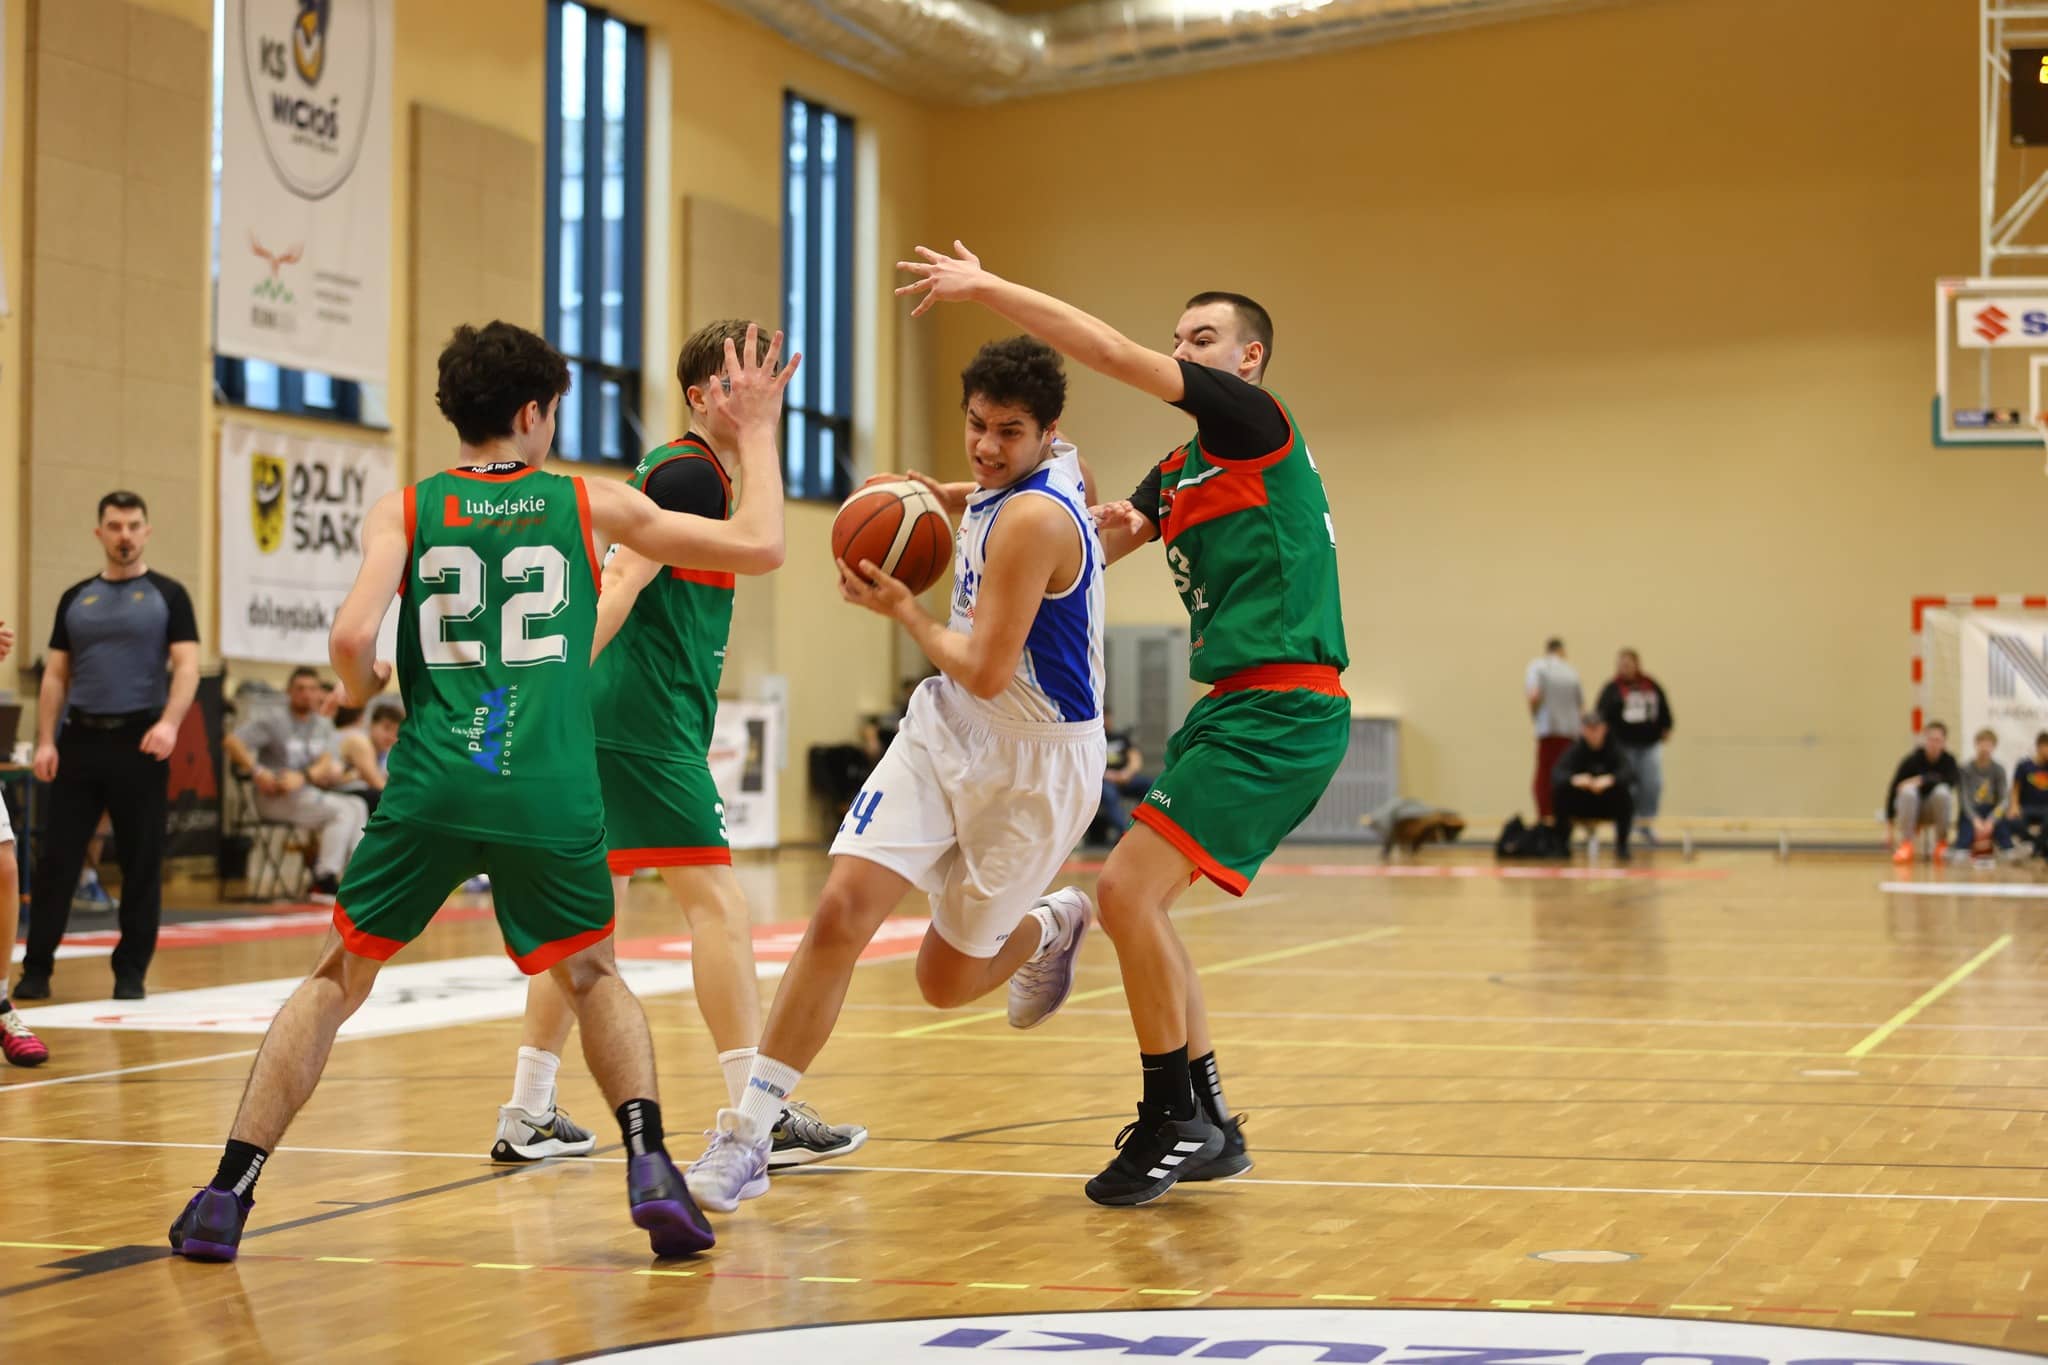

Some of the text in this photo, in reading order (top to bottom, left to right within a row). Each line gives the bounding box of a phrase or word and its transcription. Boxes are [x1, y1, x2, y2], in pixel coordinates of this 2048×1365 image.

[259, 34, 287, 82] KS
[466, 496, 546, 516] lubelskie
[418, 544, 570, 670] 22
[502, 684, 518, 776] groundwork
[920, 1328, 1972, 1365] UZUKI
